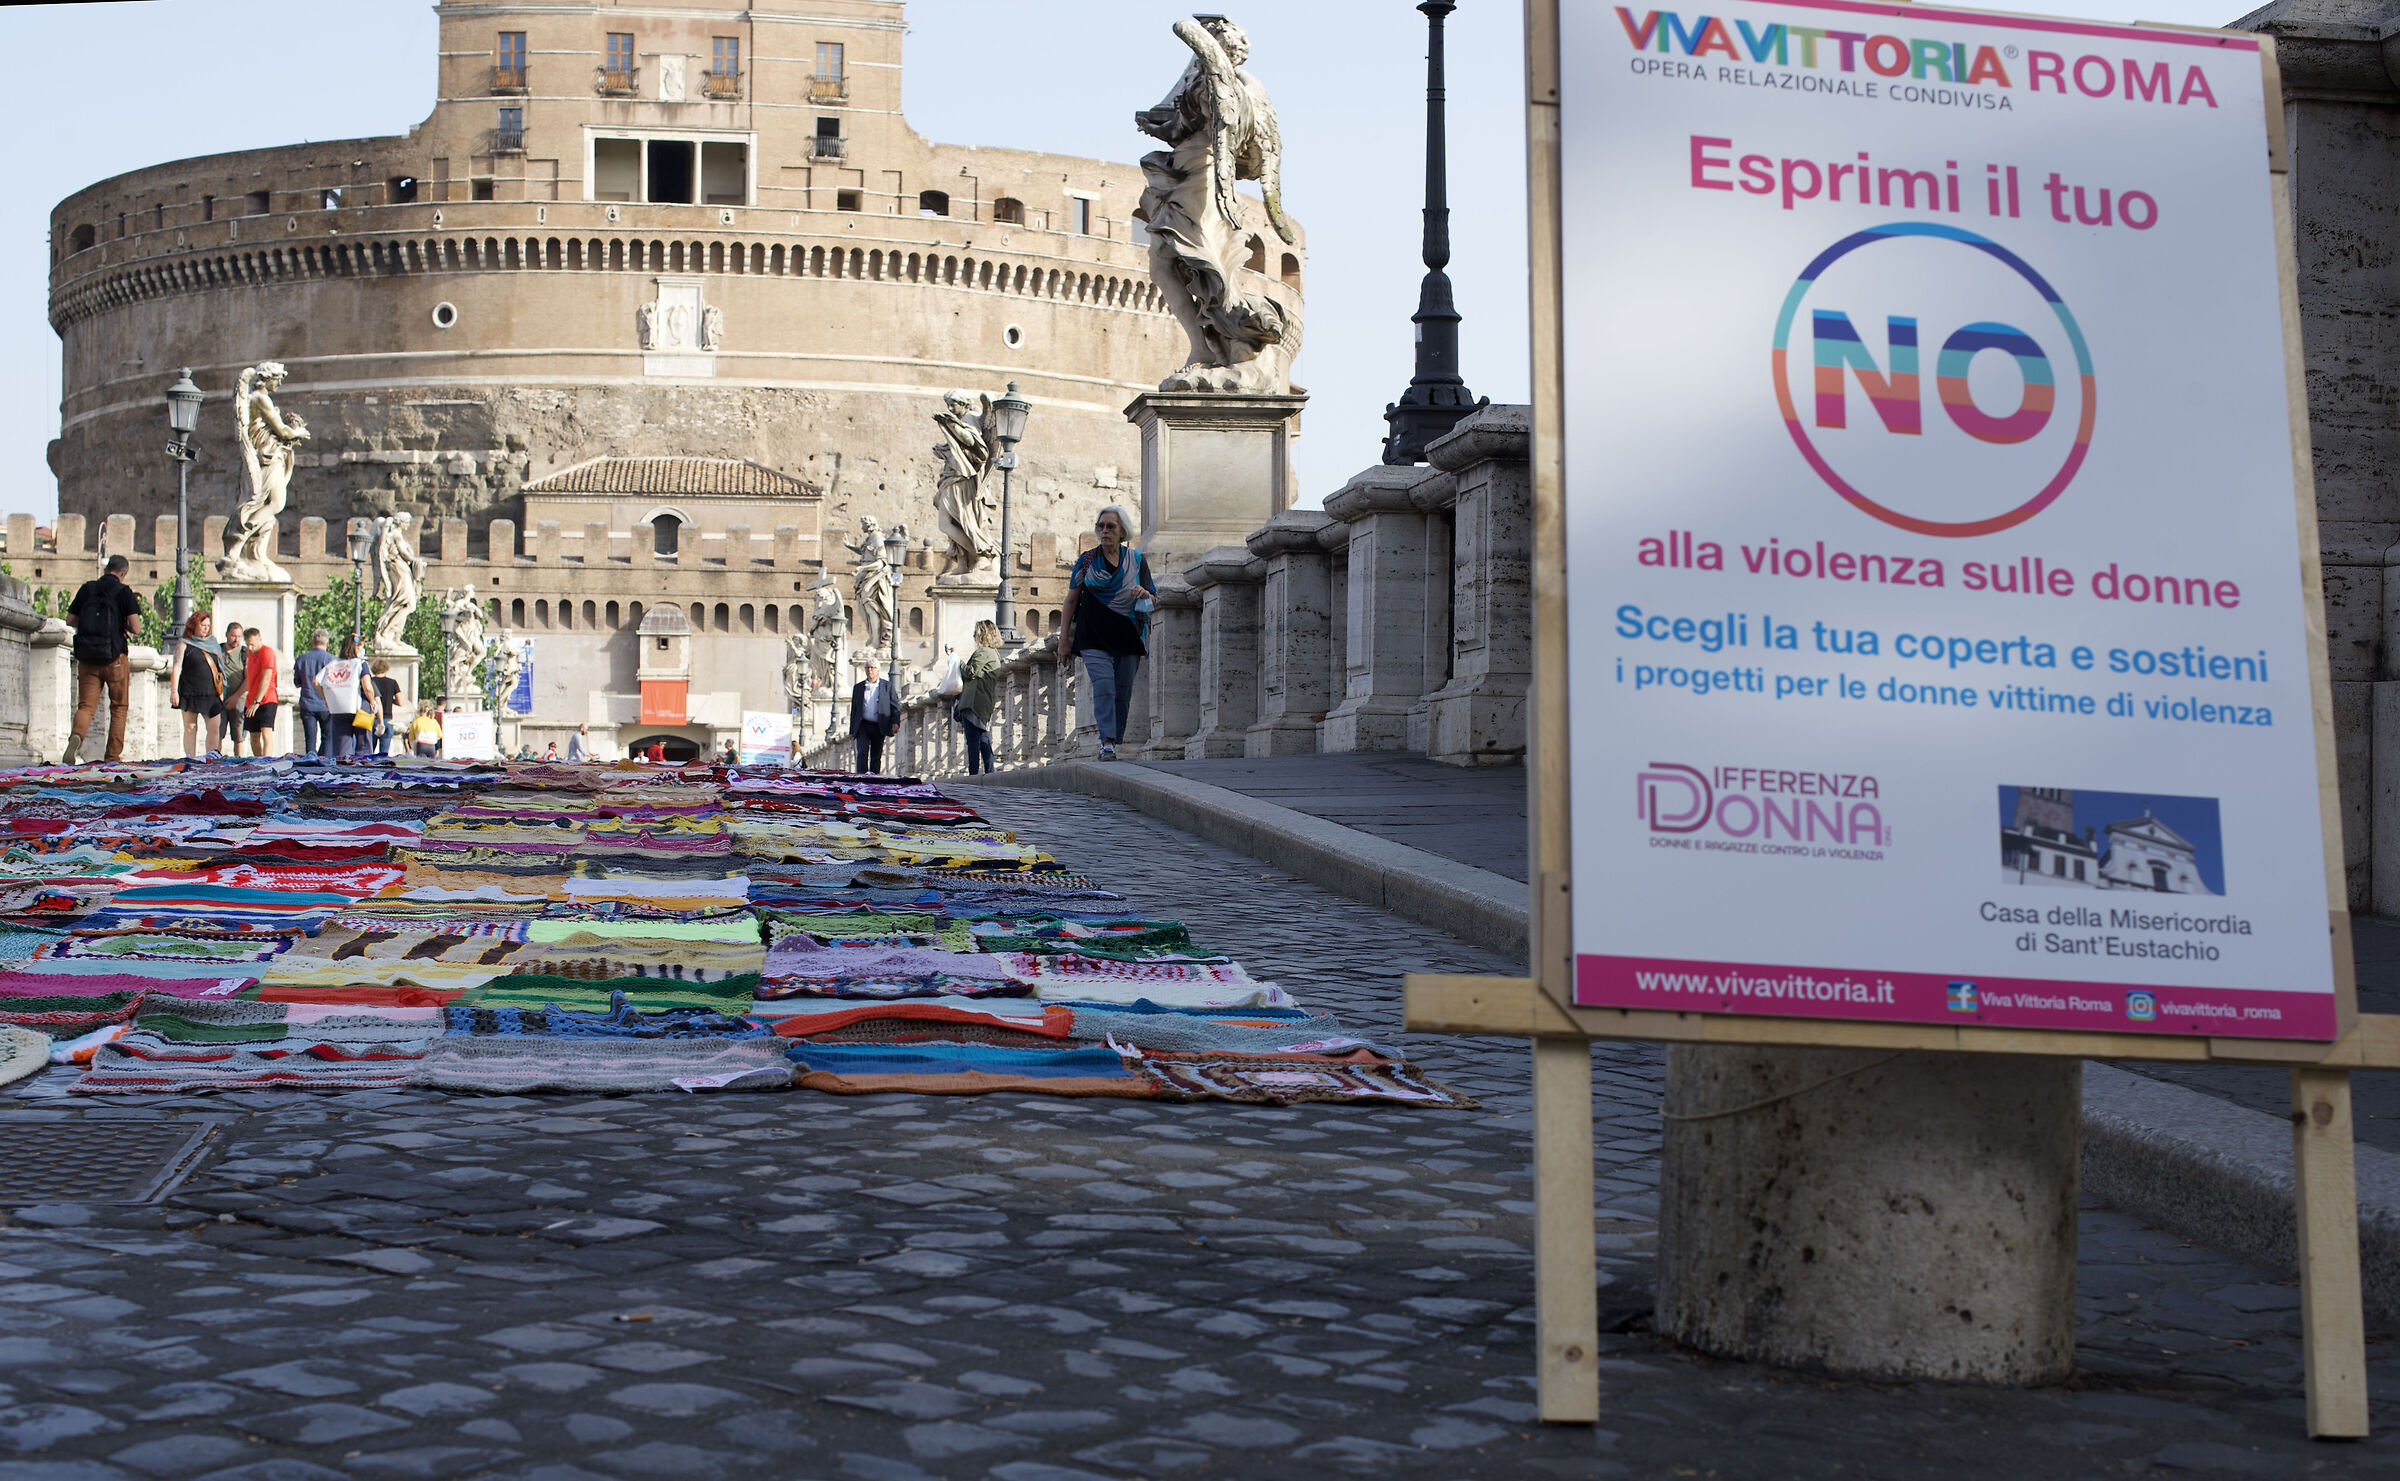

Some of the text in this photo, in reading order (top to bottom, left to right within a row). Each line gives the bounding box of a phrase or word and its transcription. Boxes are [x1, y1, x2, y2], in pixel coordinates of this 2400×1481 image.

[1630, 57, 2013, 111] OPERA RELAZIONALE CONDIVISA
[2028, 49, 2219, 108] ROMA
[1690, 134, 2159, 230] Esprimi il tuo
[1812, 308, 2056, 445] NO
[1637, 530, 2241, 609] alla violenza sulle donne
[1615, 604, 2269, 682] Scegli la tua coperta e sostieni
[1615, 657, 2273, 727] i progetti per le donne vittime di violenza
[1649, 837, 1884, 861] DONNE E RAGAZZE CONTRO LA VIOLENZA
[1980, 901, 2252, 935] Casa della Misericordia
[2015, 932, 2036, 952] di
[1635, 971, 1895, 1005] www.vivavittoria.it
[1980, 991, 2012, 1008] Viva
[2014, 993, 2066, 1011] Vittoria
[2069, 997, 2113, 1013] Roma
[2161, 1002, 2282, 1021] vivavittoria_roma
